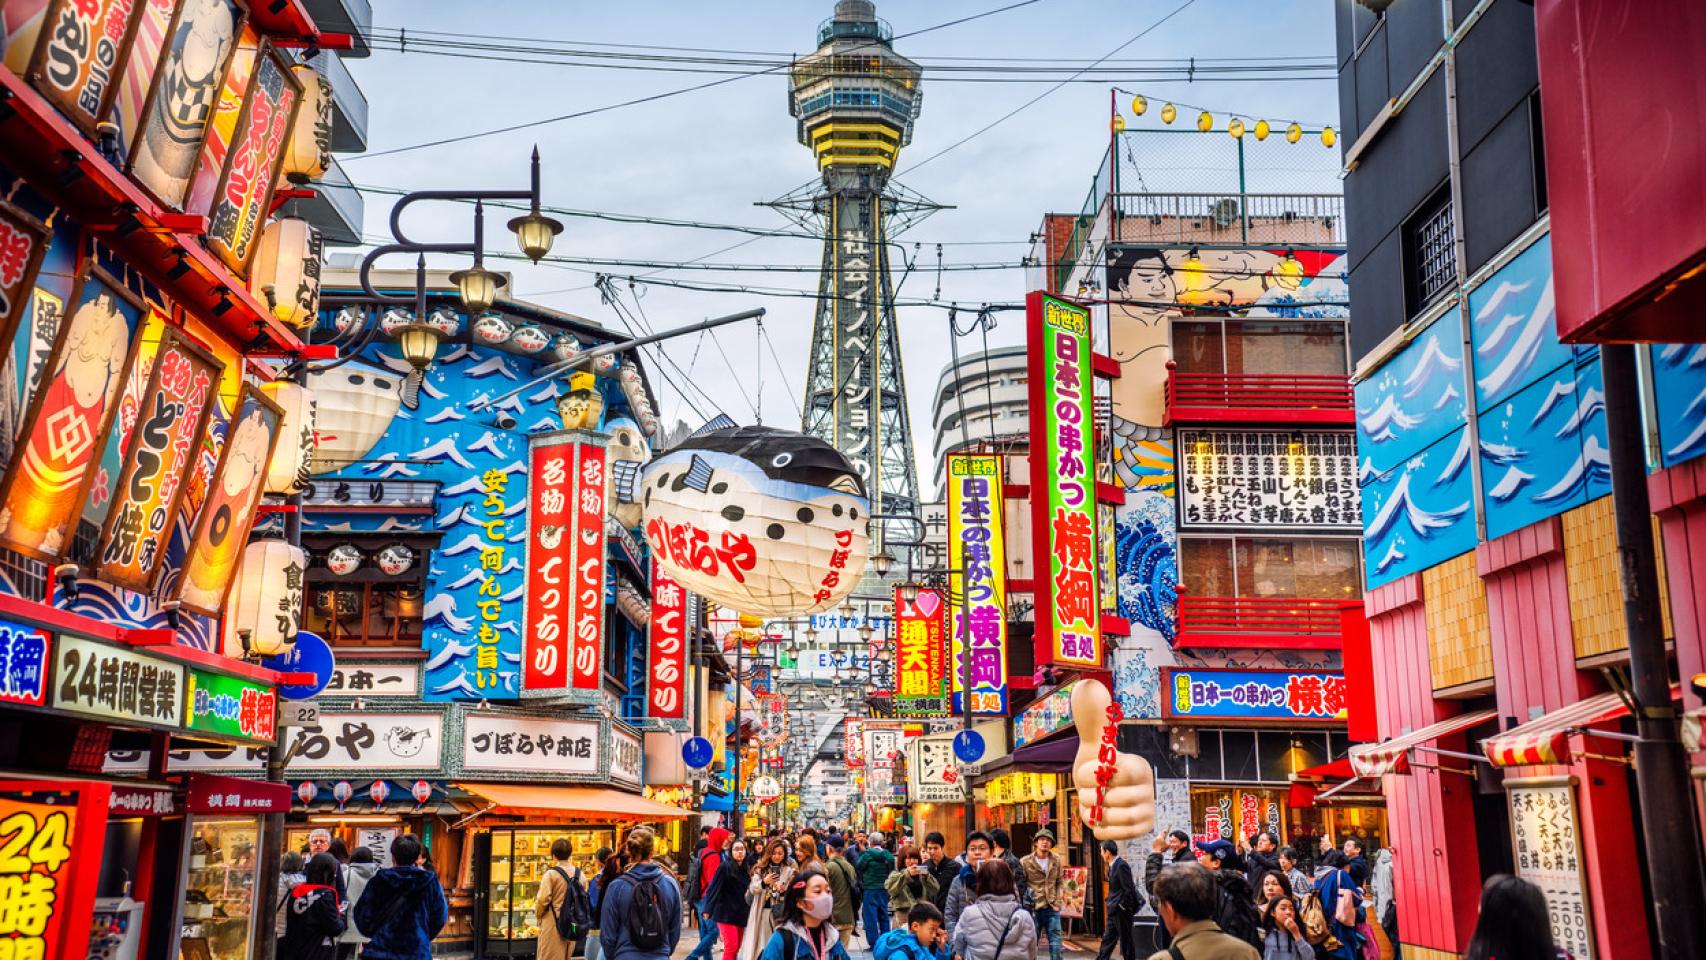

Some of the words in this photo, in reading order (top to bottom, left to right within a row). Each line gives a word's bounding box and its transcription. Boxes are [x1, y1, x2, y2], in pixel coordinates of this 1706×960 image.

[1054, 335, 1085, 506] 日本一の串かつ
[139, 370, 209, 573] 大阪下町の味
[541, 457, 565, 515] 名物
[1186, 476, 1199, 522] もち
[1216, 476, 1232, 522] 紅しょうが
[1231, 477, 1247, 522] にんにく
[1247, 477, 1262, 523] 玉ねぎ
[1293, 478, 1310, 523] れんこん
[1325, 478, 1339, 523] 白ねぎ
[646, 516, 757, 583] づぼらや
[961, 478, 993, 602] 日本一の串かつ
[1054, 509, 1096, 629] 横綱
[901, 620, 929, 695] 通天閣
[930, 621, 940, 695] TSUTENKAKU
[957, 606, 1002, 689] 横綱
[1061, 633, 1095, 660] 酒処
[60, 649, 176, 720] 24時間営業
[1192, 683, 1285, 706] 日本一の串かつ
[472, 731, 592, 758] づぼらや本店
[1220, 799, 1232, 837] ソースの
